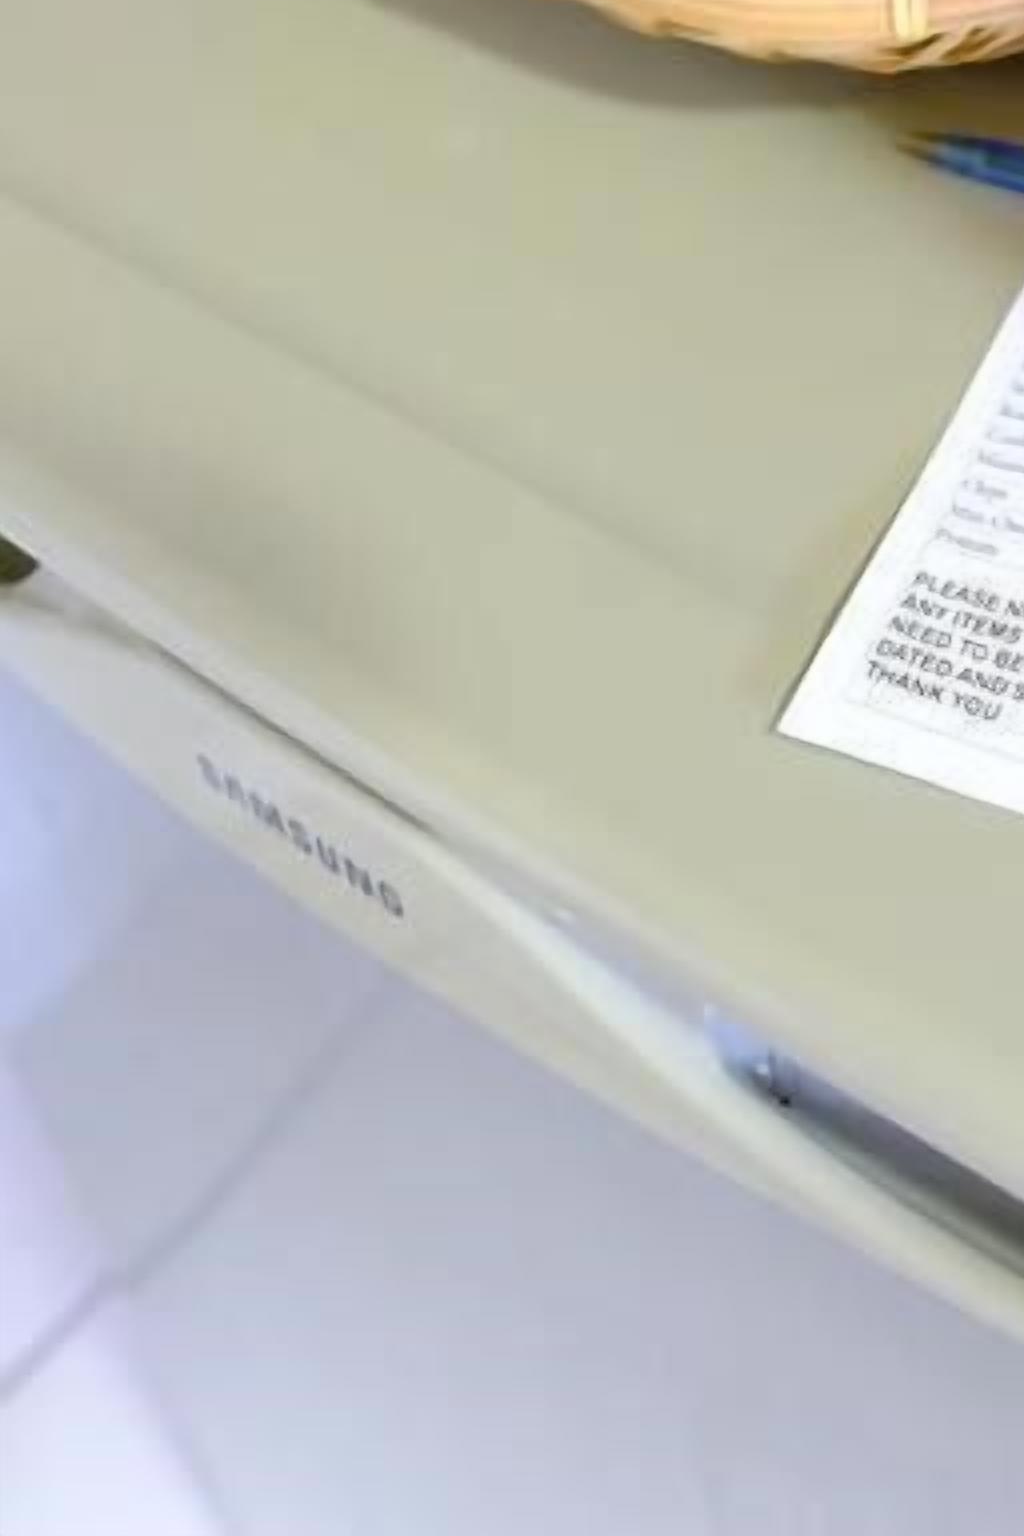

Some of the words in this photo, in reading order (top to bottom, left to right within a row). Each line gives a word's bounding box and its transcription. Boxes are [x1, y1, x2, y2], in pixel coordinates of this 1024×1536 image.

[900, 592, 948, 620] ANY
[952, 610, 1022, 645] ITEMS
[913, 571, 1000, 612] PLEASE
[876, 636, 952, 677] DATED
[956, 667, 1009, 696] AND
[890, 615, 951, 650] NEED
[961, 637, 989, 661] TO
[868, 659, 943, 704] THANK
[953, 690, 1004, 721] YOU
[197, 753, 405, 919] SAMSUNG
